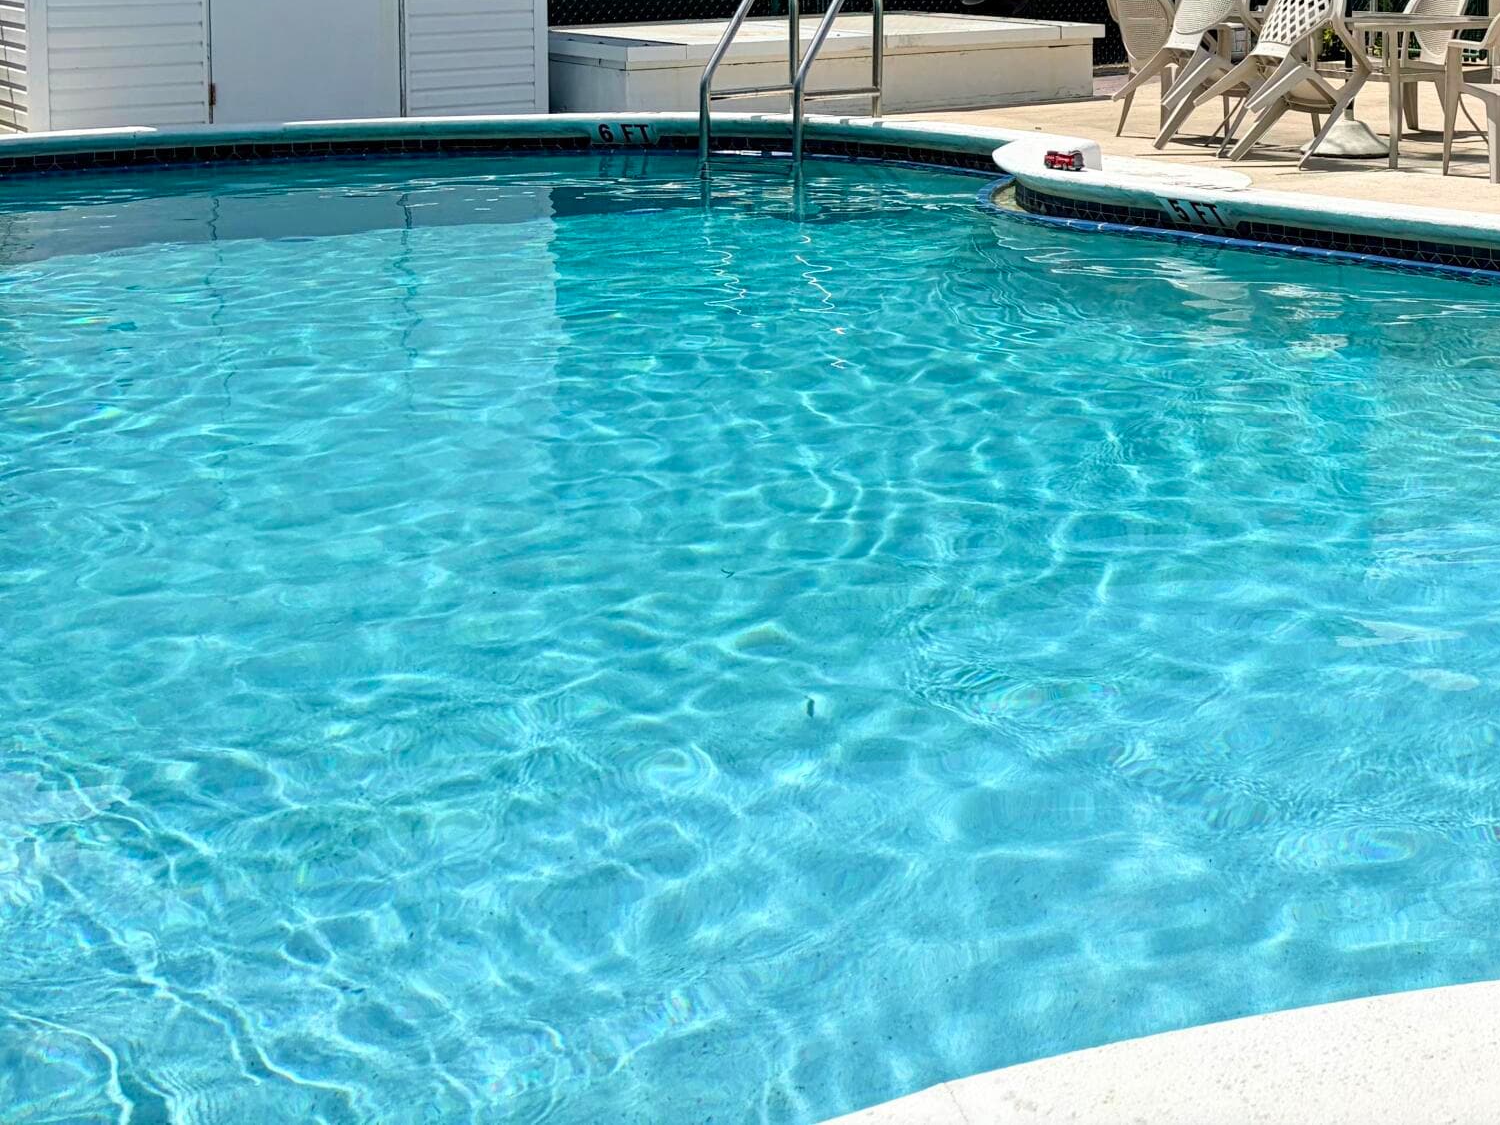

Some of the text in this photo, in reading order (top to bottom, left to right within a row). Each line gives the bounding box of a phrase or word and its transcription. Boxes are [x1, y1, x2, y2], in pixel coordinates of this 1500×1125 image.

[598, 123, 650, 144] 6 FT
[1167, 198, 1227, 227] 5 FT
